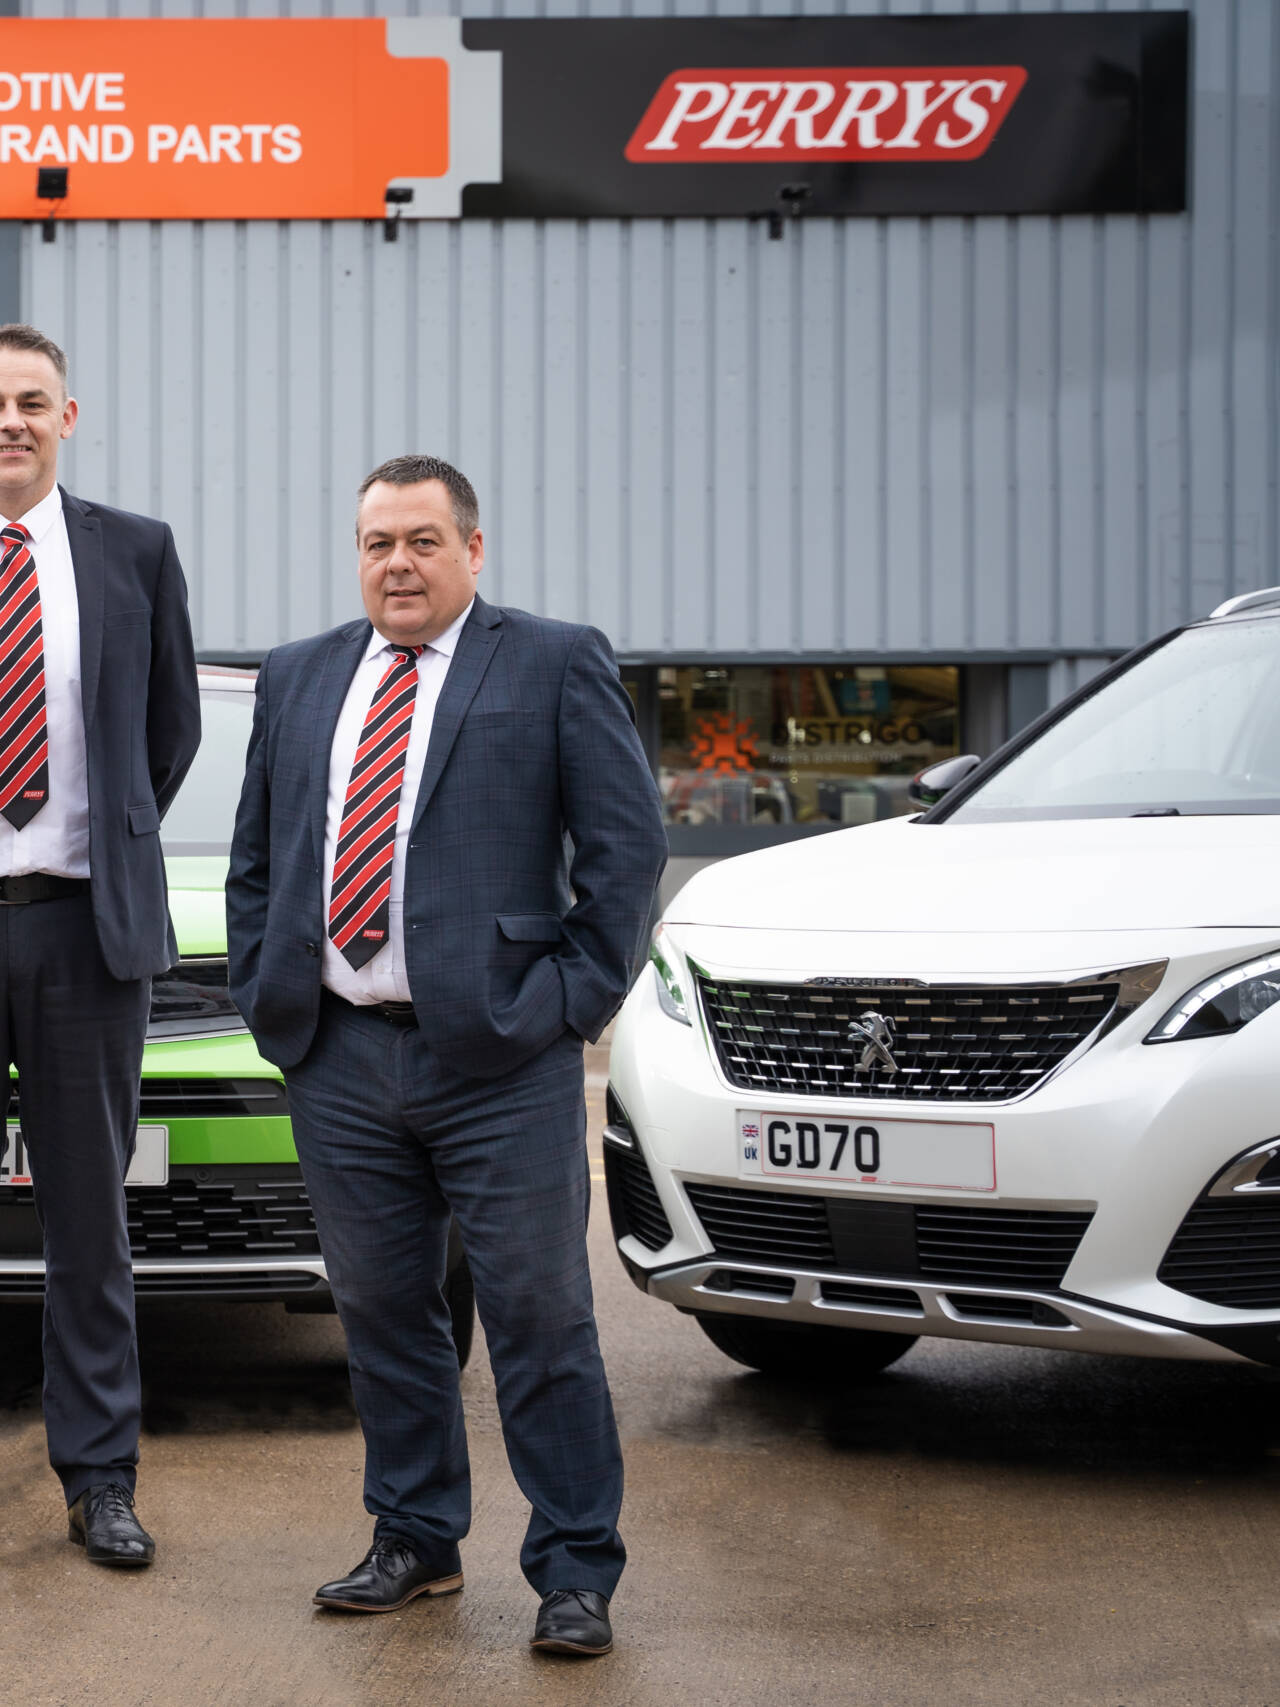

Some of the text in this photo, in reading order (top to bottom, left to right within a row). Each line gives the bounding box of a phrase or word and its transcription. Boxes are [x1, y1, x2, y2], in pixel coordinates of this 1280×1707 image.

[644, 79, 1006, 151] PERRYS
[147, 124, 302, 163] PARTS
[819, 976, 914, 987] PEUGEOT
[744, 1147, 758, 1161] UK
[768, 1121, 880, 1173] GD70
